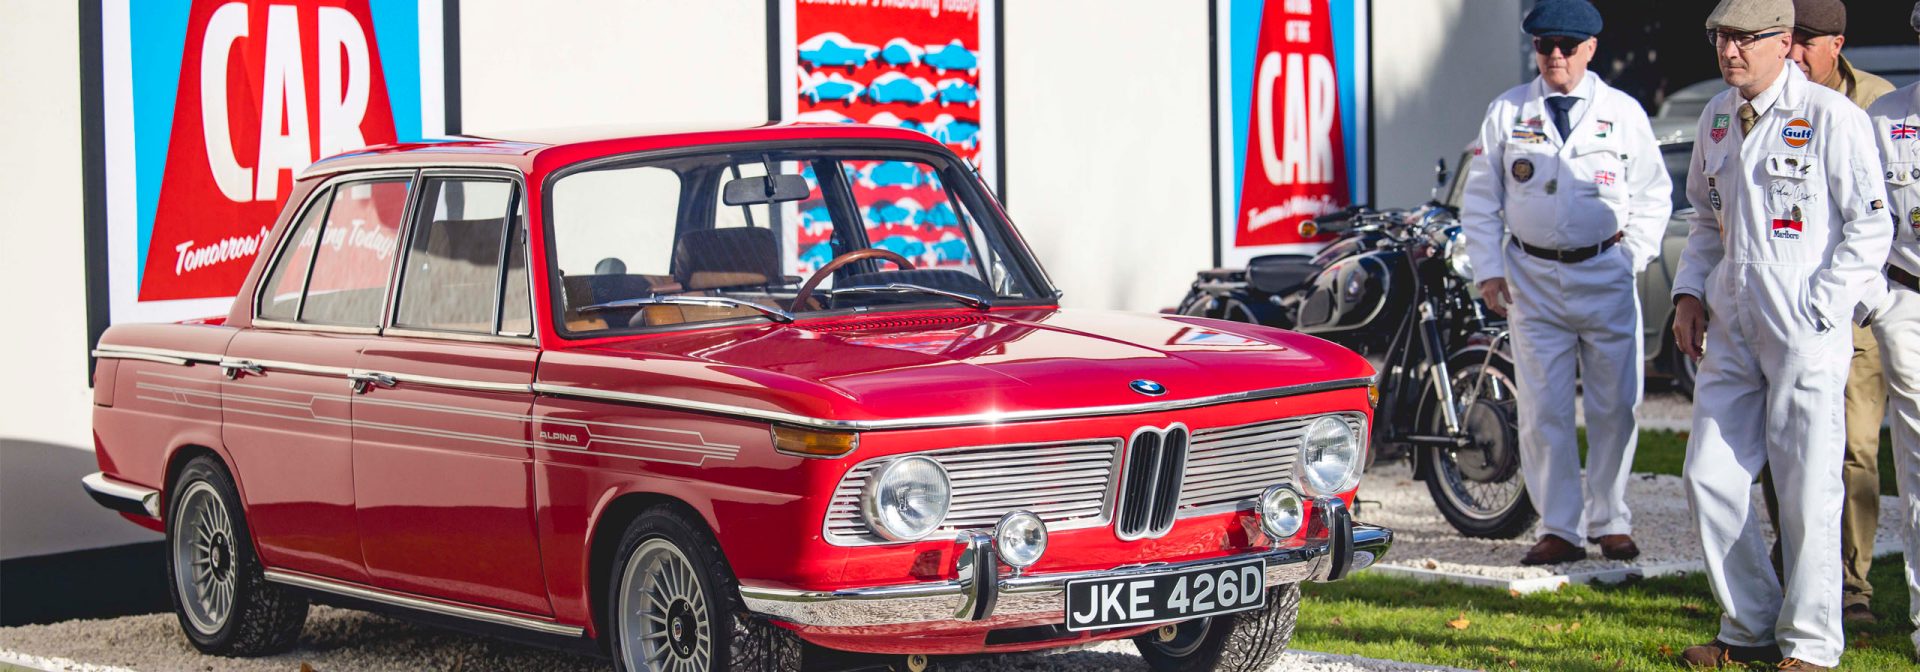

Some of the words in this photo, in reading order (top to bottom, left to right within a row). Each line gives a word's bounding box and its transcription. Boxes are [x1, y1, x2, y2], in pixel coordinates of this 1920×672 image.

[201, 2, 371, 203] CAR
[1257, 51, 1336, 186] CAR
[1783, 127, 1812, 139] Gulf
[540, 431, 578, 442] ALPINA
[1073, 579, 1155, 625] JKE
[1167, 566, 1262, 614] 426D
